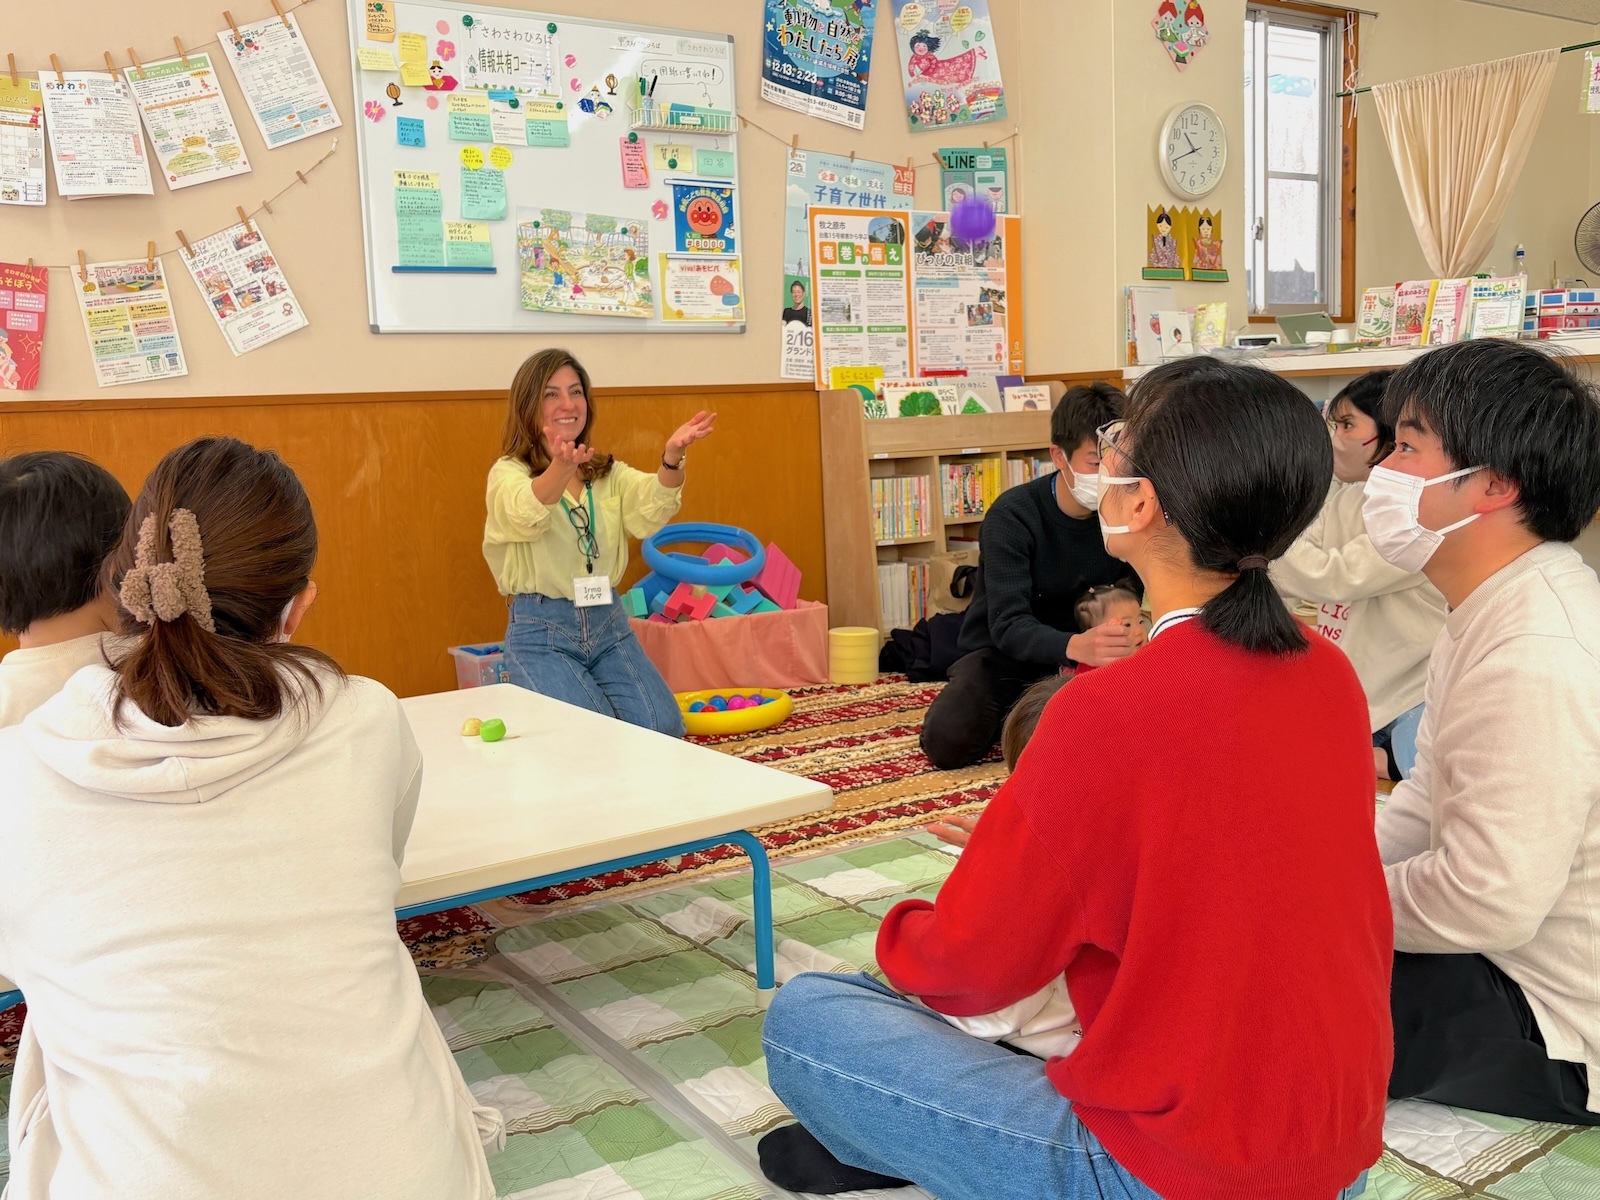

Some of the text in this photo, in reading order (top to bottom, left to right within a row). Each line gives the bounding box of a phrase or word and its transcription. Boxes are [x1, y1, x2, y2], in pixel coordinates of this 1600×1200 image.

[481, 26, 554, 45] さわさわひろば
[777, 25, 859, 70] わたしたち展
[772, 61, 817, 83] 12/13 2/23
[1181, 118, 1188, 129] 11
[1190, 113, 1198, 125] 12
[1173, 128, 1181, 140] 10
[1209, 130, 1215, 142] 2
[1169, 144, 1175, 155] 9
[1212, 146, 1218, 158] 3
[948, 155, 975, 169] LINE
[1172, 160, 1178, 171] 8
[1207, 162, 1212, 173] 4
[1180, 171, 1186, 183] 7
[1189, 175, 1195, 187] 6
[1200, 172, 1206, 184] 5
[814, 185, 886, 208] 子育て世代
[819, 221, 846, 230] 牧之原市
[190, 248, 228, 270] ボランティア
[1398, 288, 1429, 297] 絵本のある子
[786, 331, 813, 347] 2/16
